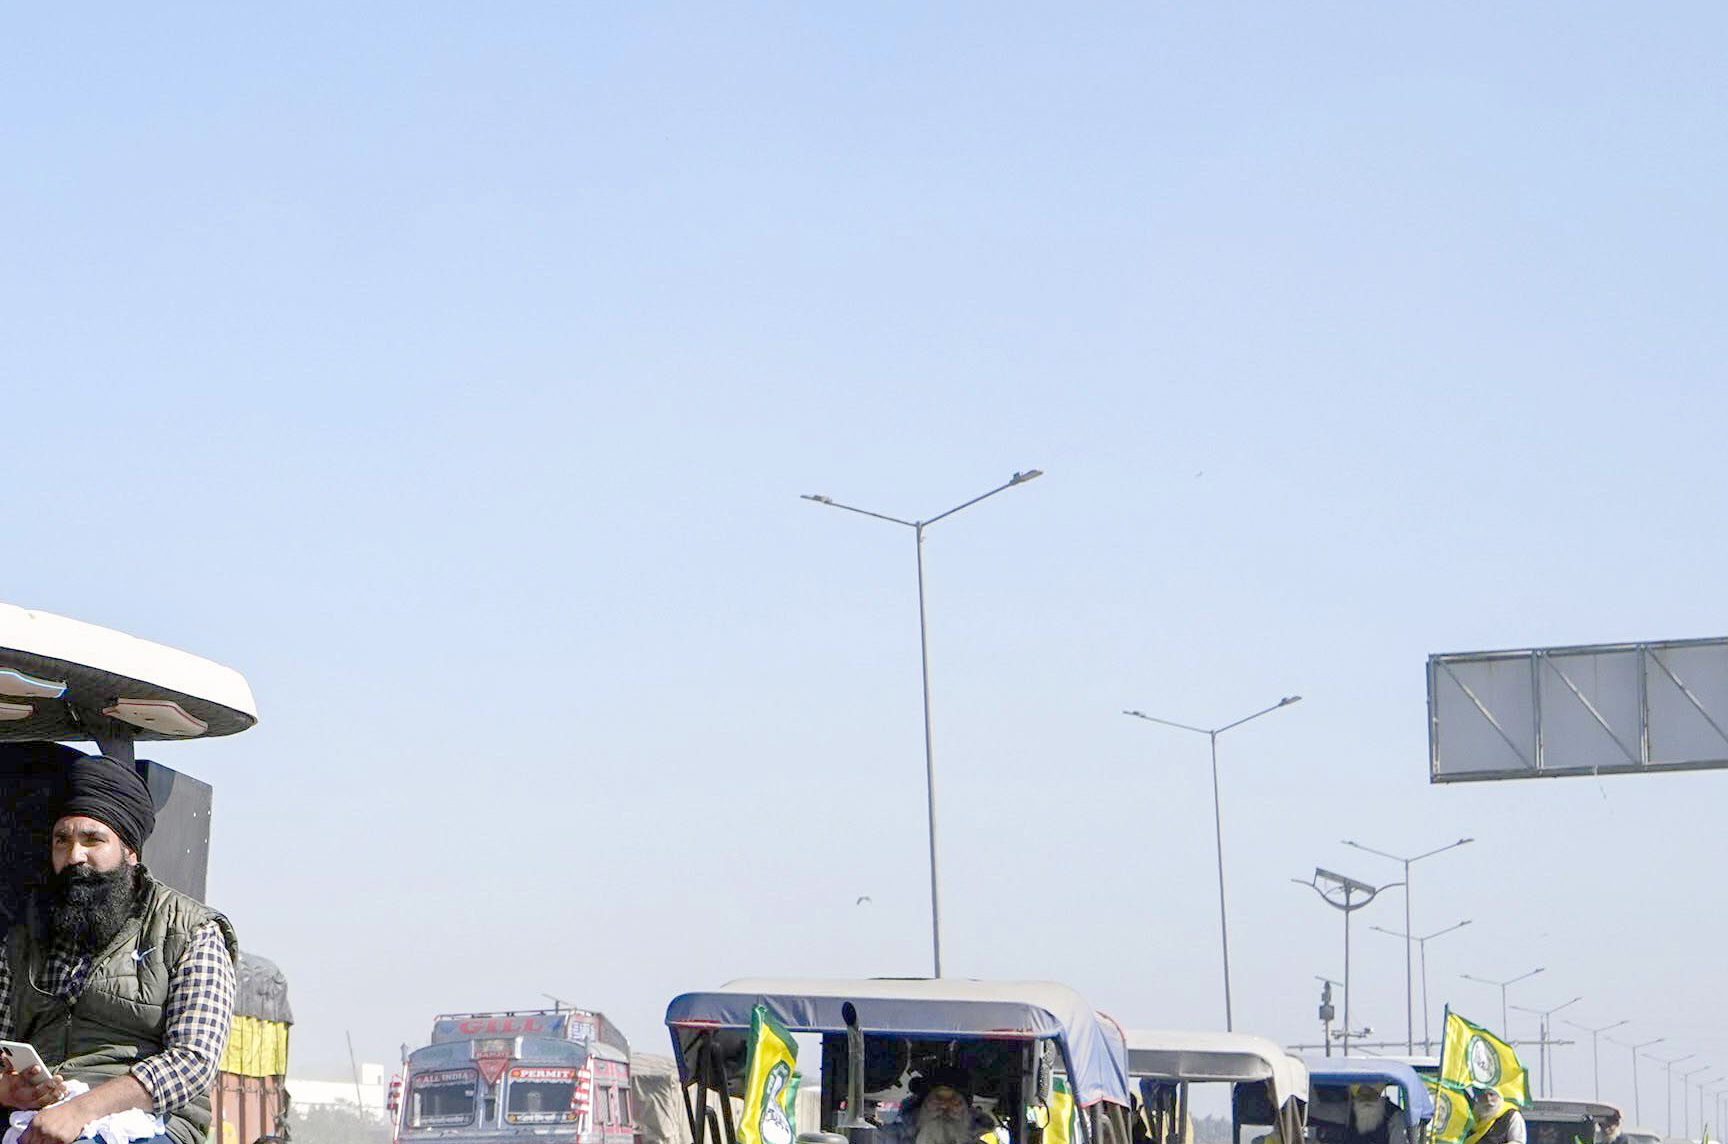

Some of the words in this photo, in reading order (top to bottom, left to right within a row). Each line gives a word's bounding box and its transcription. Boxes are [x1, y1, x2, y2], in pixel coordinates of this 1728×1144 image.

[458, 1018, 544, 1035] GILL
[423, 1073, 441, 1084] ALL
[441, 1071, 470, 1082] INDIA
[519, 1068, 570, 1080] PERMIT
